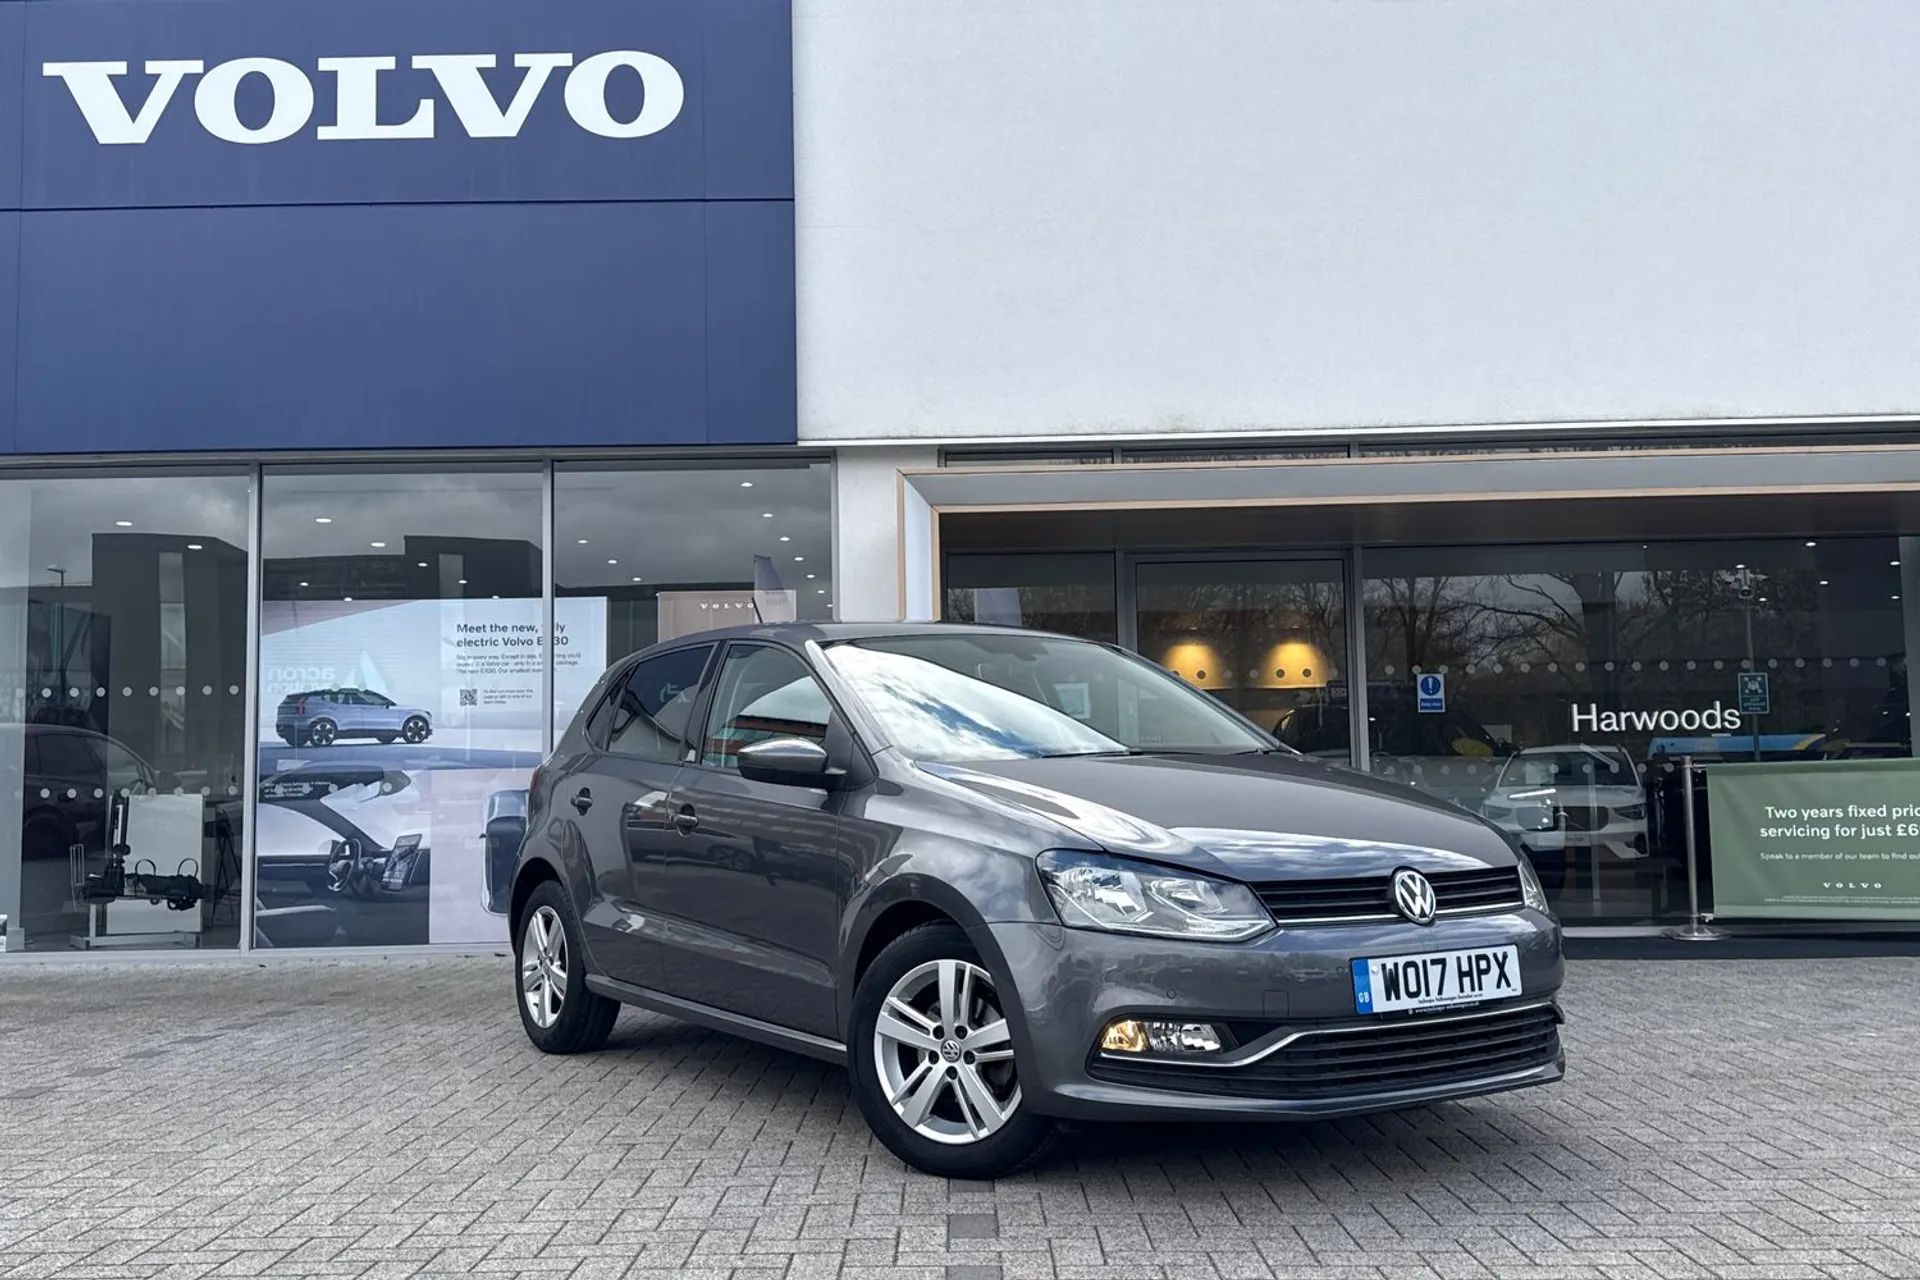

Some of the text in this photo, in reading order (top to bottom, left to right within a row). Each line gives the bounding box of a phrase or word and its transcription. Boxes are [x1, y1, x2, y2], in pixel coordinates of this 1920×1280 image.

[42, 50, 685, 145] VOLVO
[700, 602, 754, 610] VOLVO
[456, 623, 487, 634] Meet
[490, 622, 509, 633] the
[511, 624, 538, 634] new,
[456, 636, 569, 647] electric Volvo E30
[1572, 700, 1741, 732] Harwoods
[1764, 806, 1797, 818] Two
[1801, 807, 1844, 821] years
[1848, 804, 1887, 818] fixed
[1760, 824, 1830, 840] servicing
[1835, 824, 1857, 837] for
[1861, 824, 1892, 840] just
[1760, 852, 1783, 861] Speak
[1801, 852, 1833, 860] member
[1834, 852, 1843, 860] of
[1859, 852, 1879, 860] team
[1881, 852, 1890, 860] to
[1891, 851, 1907, 860] find
[1823, 882, 1882, 890] VOLVO
[1380, 951, 1512, 1002] WO17 HPX
[1358, 991, 1370, 1004] GB
